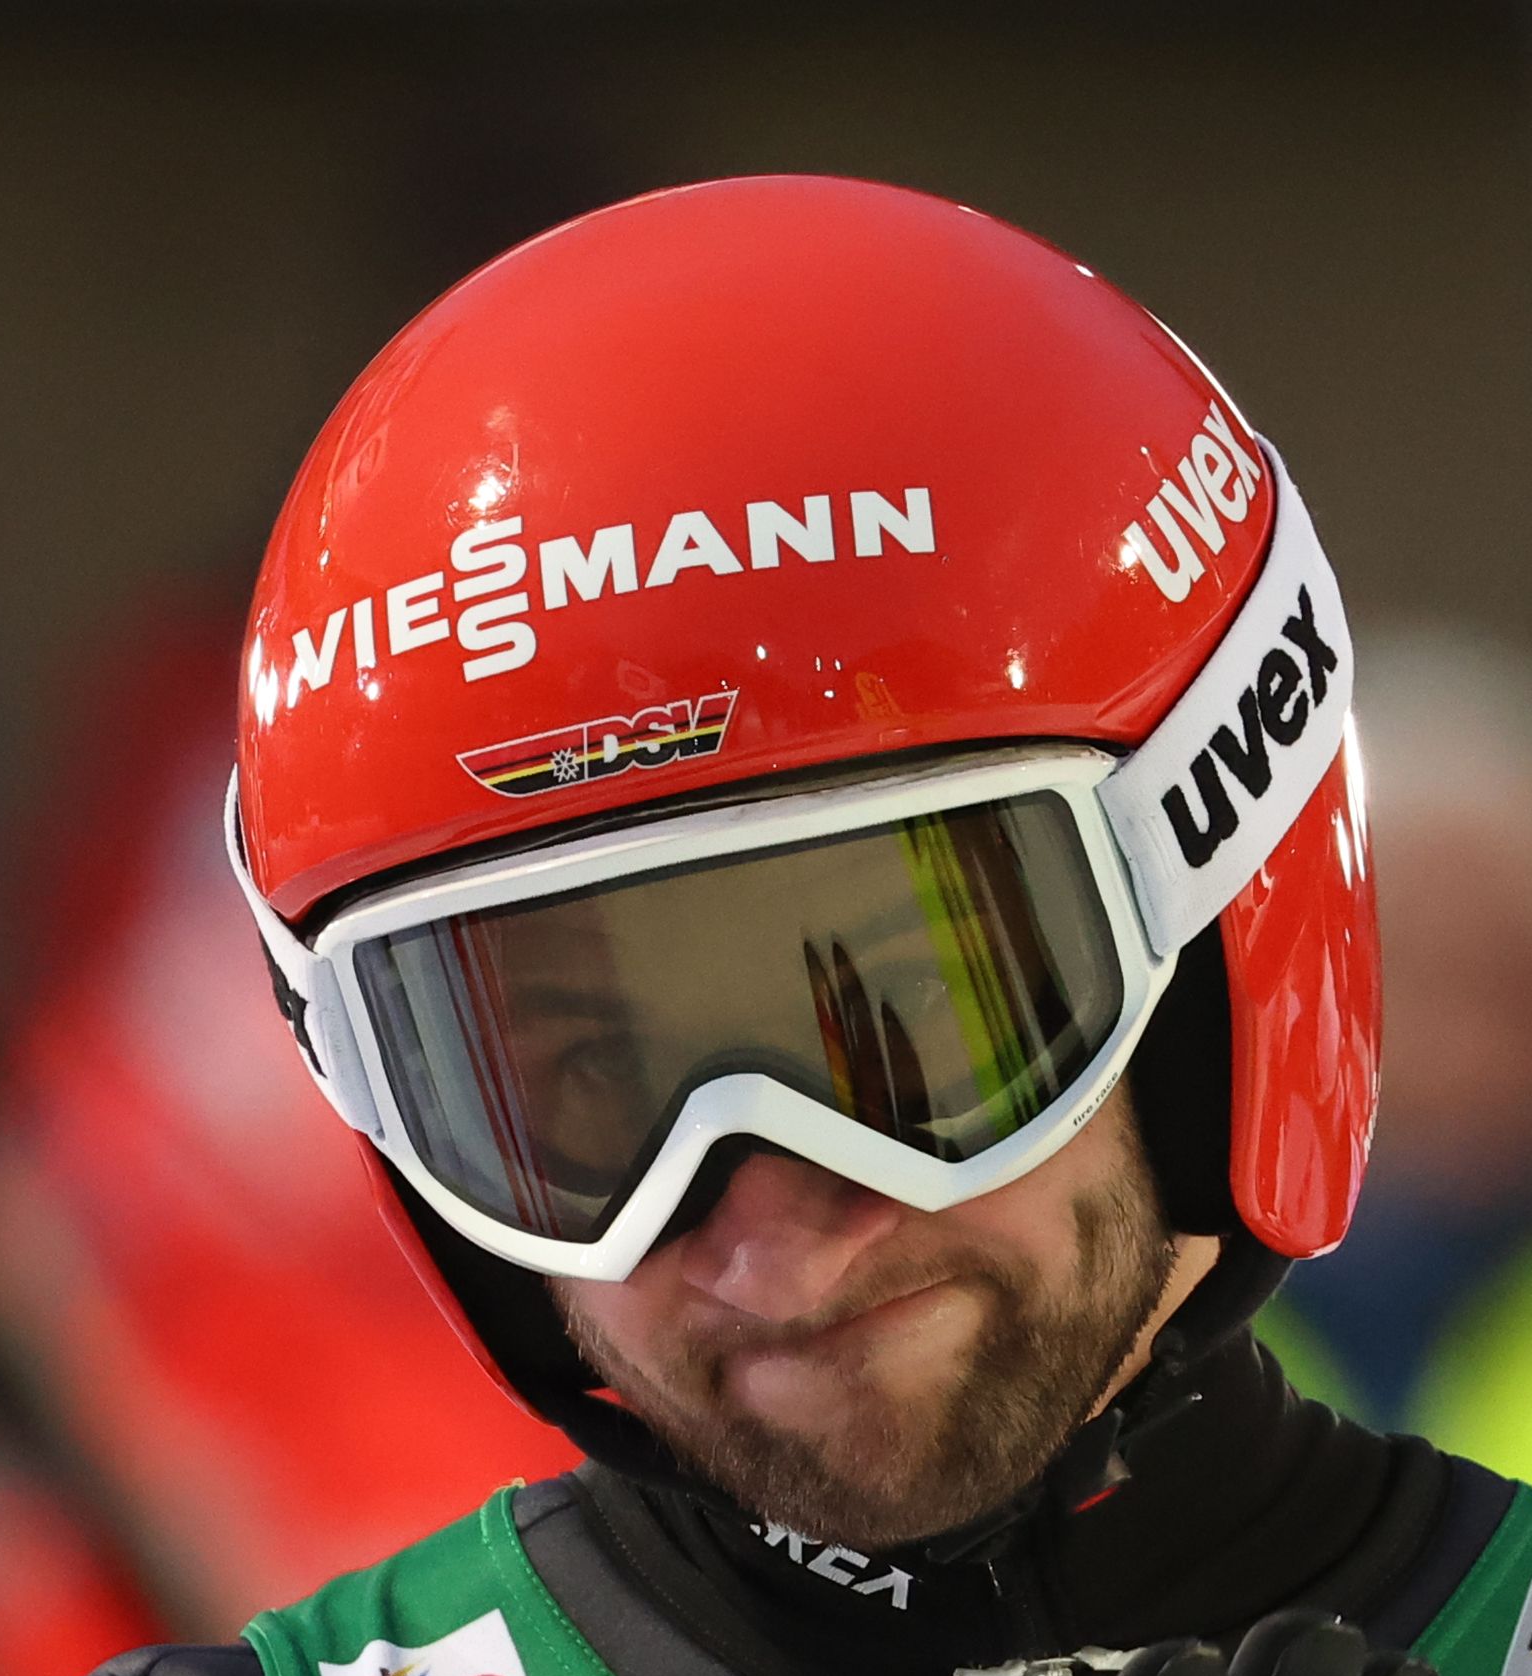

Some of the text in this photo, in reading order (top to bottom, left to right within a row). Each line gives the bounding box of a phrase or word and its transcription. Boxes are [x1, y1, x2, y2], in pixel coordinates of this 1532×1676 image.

[292, 488, 936, 691] VIESSMANN
[1122, 400, 1261, 603] uvex
[585, 690, 739, 781] DSV
[1161, 583, 1337, 868] uvex
